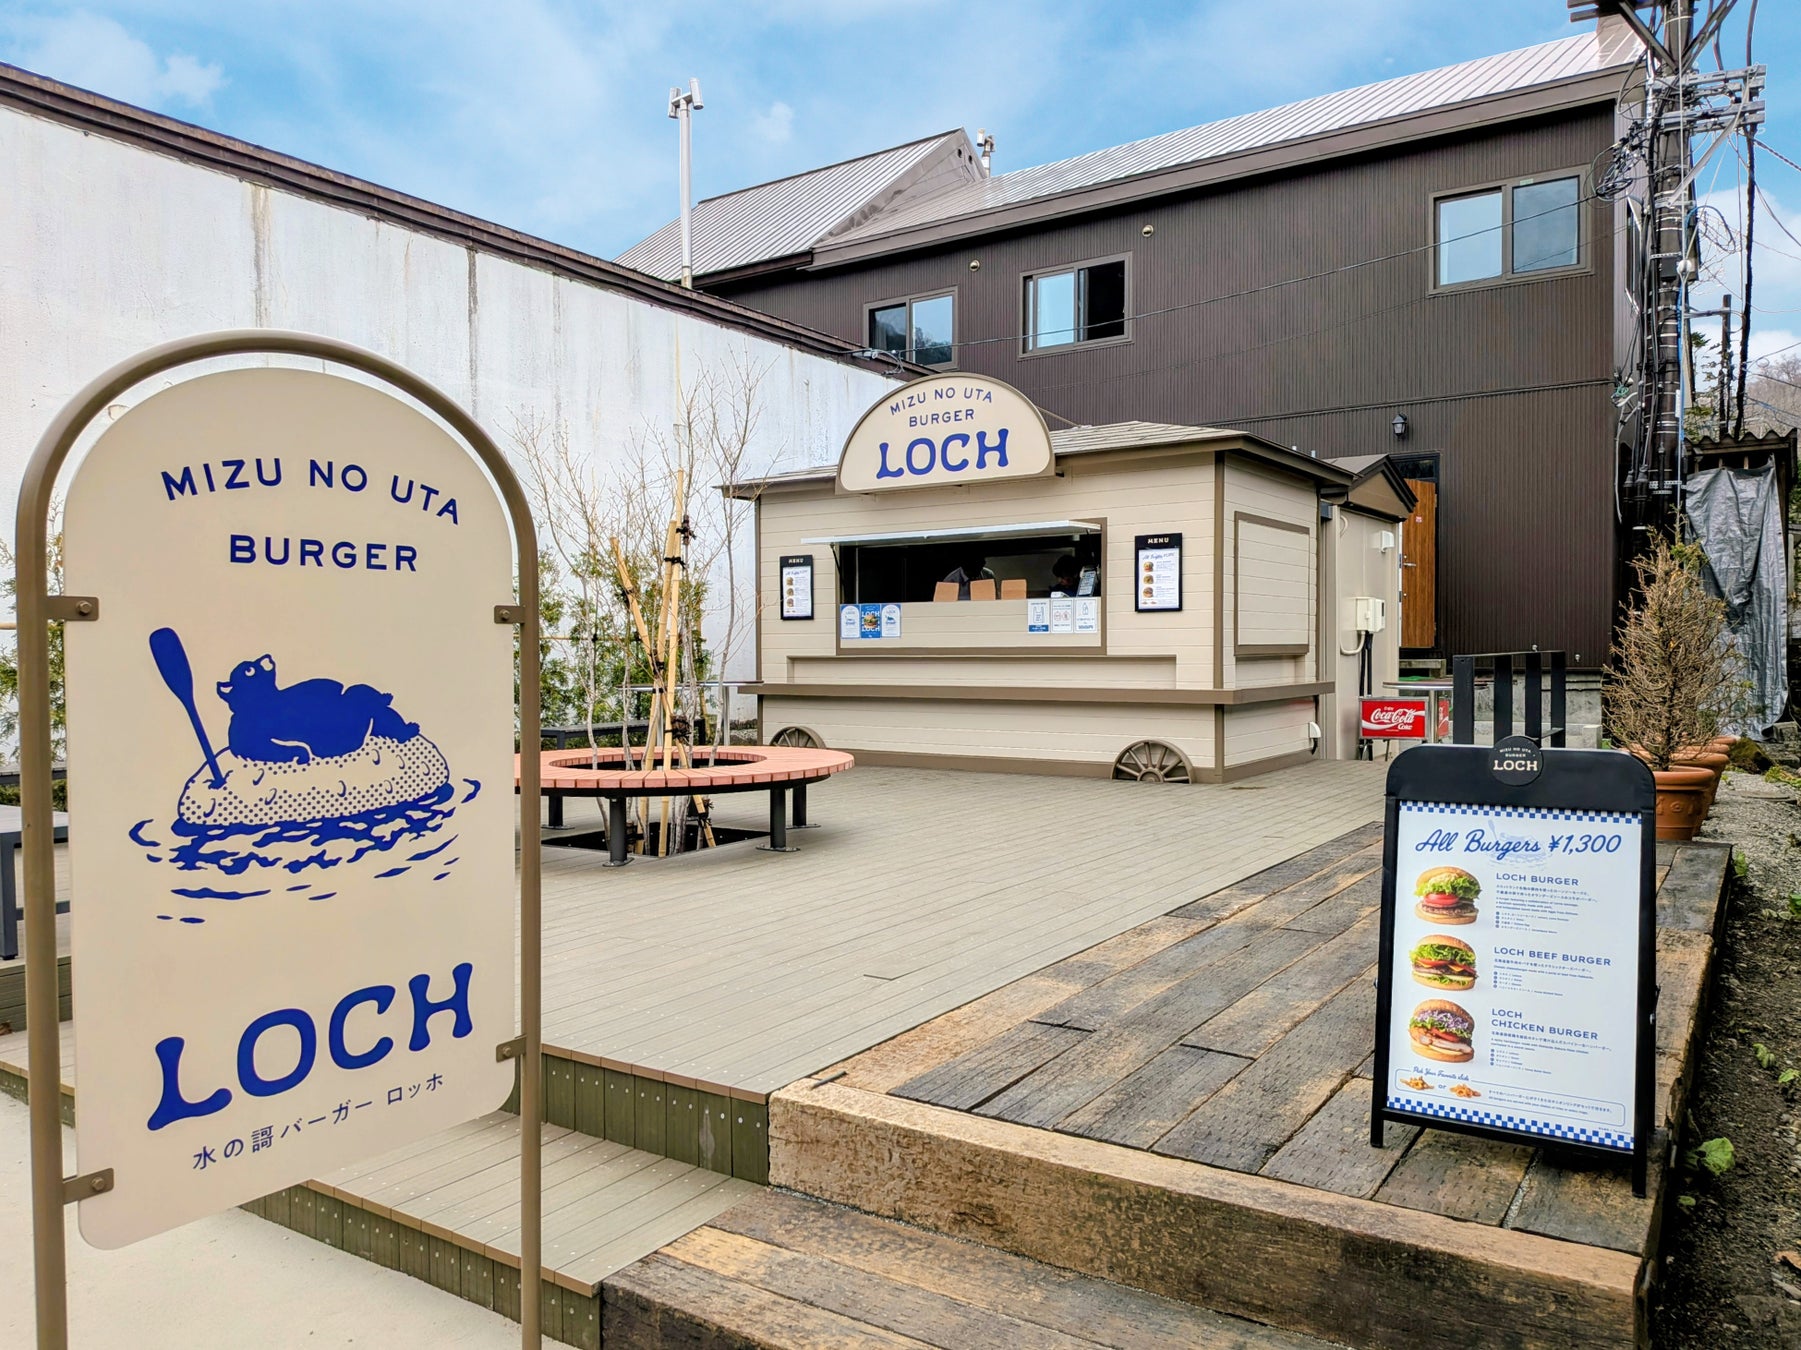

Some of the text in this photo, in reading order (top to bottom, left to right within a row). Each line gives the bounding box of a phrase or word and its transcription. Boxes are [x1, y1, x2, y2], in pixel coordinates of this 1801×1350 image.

[890, 386, 994, 416] MIZU NO UTA
[908, 408, 975, 427] BURGER
[876, 428, 1010, 479] LOCH
[161, 458, 460, 524] MIZU NO UTA
[230, 534, 418, 572] BURGER
[1492, 759, 1538, 771] LOCH
[1415, 829, 1623, 862] All Burgers ¥1,300
[1496, 872, 1579, 886] LOCH BURGER
[1494, 946, 1525, 957] LOCH
[1528, 950, 1558, 960] BEEF
[1561, 954, 1612, 967] BURGER
[1491, 1008, 1523, 1019] LOCH
[1491, 1019, 1599, 1041] CHICKEN BURGER
[147, 962, 474, 1131] LOCH
[386, 1073, 444, 1106] ロッホ
